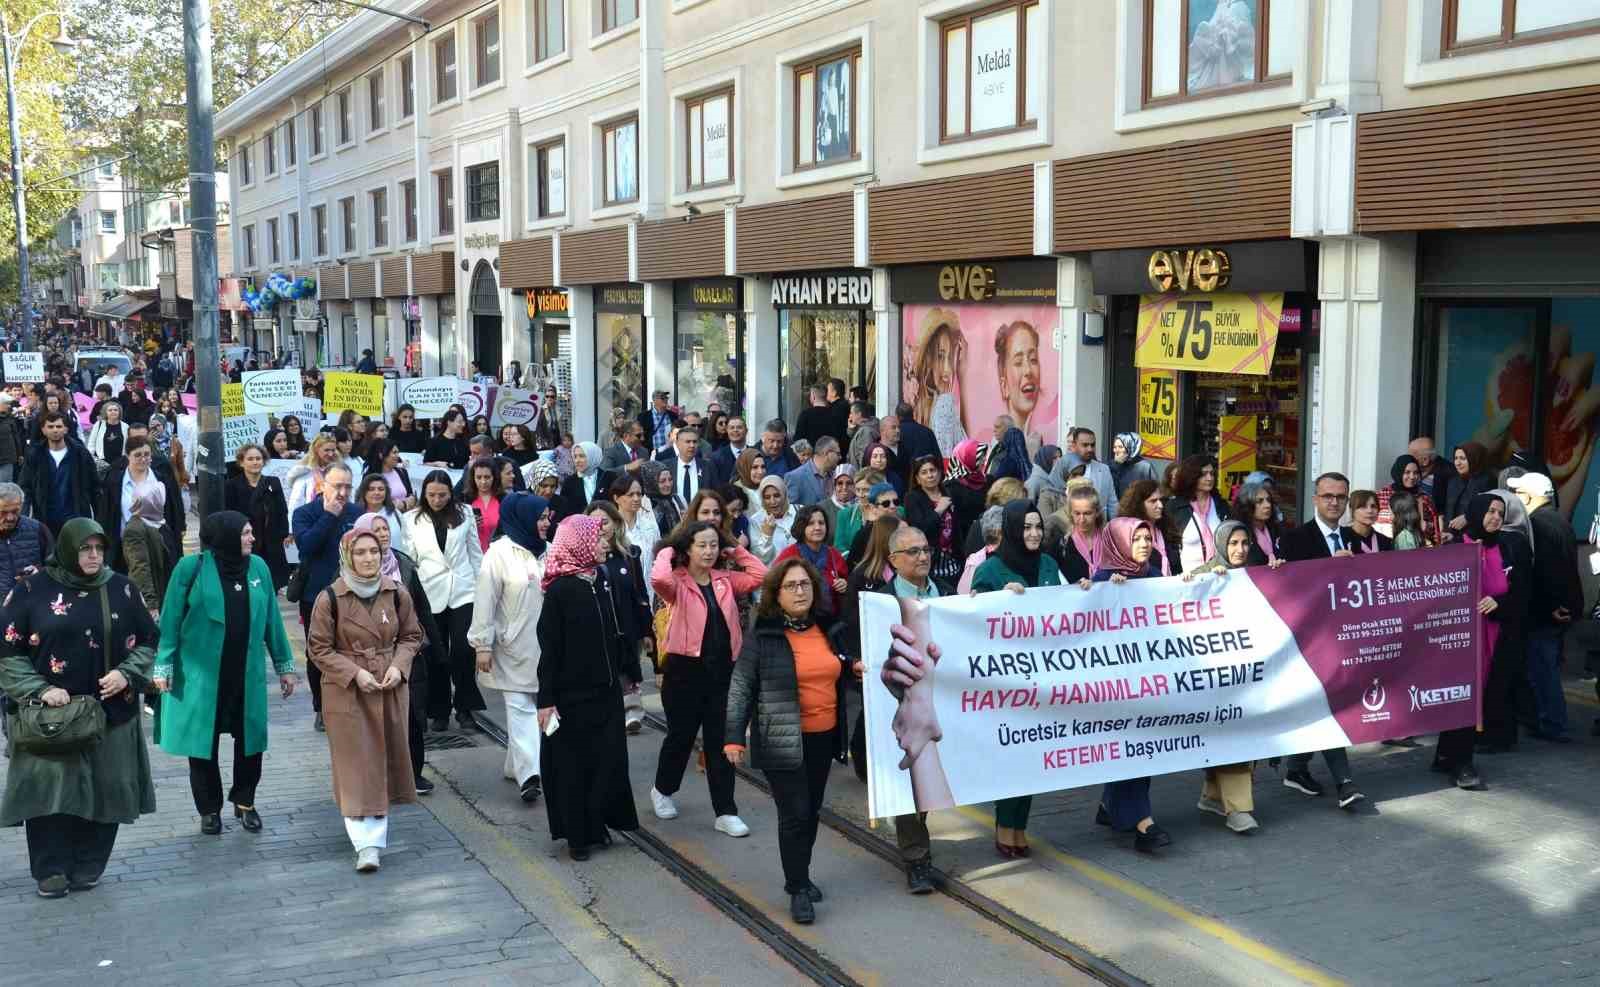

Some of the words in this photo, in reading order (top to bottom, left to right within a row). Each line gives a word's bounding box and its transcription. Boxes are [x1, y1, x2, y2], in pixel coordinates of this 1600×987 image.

[977, 48, 1010, 75] Melda
[939, 265, 988, 300] eve
[1148, 249, 1222, 292] eve
[770, 277, 822, 305] AYHAN
[826, 276, 872, 305] PERD
[1160, 311, 1176, 327] NET
[1215, 309, 1240, 327] BÜYÜK
[1213, 331, 1227, 346] EVE
[1151, 377, 1174, 416] 75
[1141, 417, 1174, 437] İNDİRİM
[1375, 578, 1387, 605] EKİM
[1387, 576, 1421, 591] MEME
[1423, 568, 1470, 587] KANSERİ
[986, 611, 1035, 640] TÜM
[1041, 606, 1148, 637] KADINLAR
[1154, 598, 1225, 626] ELELE
[968, 652, 1038, 680] KARŞI
[1042, 642, 1142, 673] KOYALIM
[1146, 629, 1253, 661] KANSERE
[961, 682, 1041, 713] HAYDİ,
[1049, 674, 1169, 706] HANIMLAR
[1174, 661, 1265, 693] KETEM'E
[1420, 684, 1472, 704] KETEM
[998, 723, 1067, 746] Ücretsiz
[1071, 717, 1132, 737] kanser
[1135, 711, 1210, 729] taraması
[1214, 703, 1243, 727] için
[1043, 742, 1121, 770] KETEM'E
[1125, 734, 1206, 760] başvurun.
